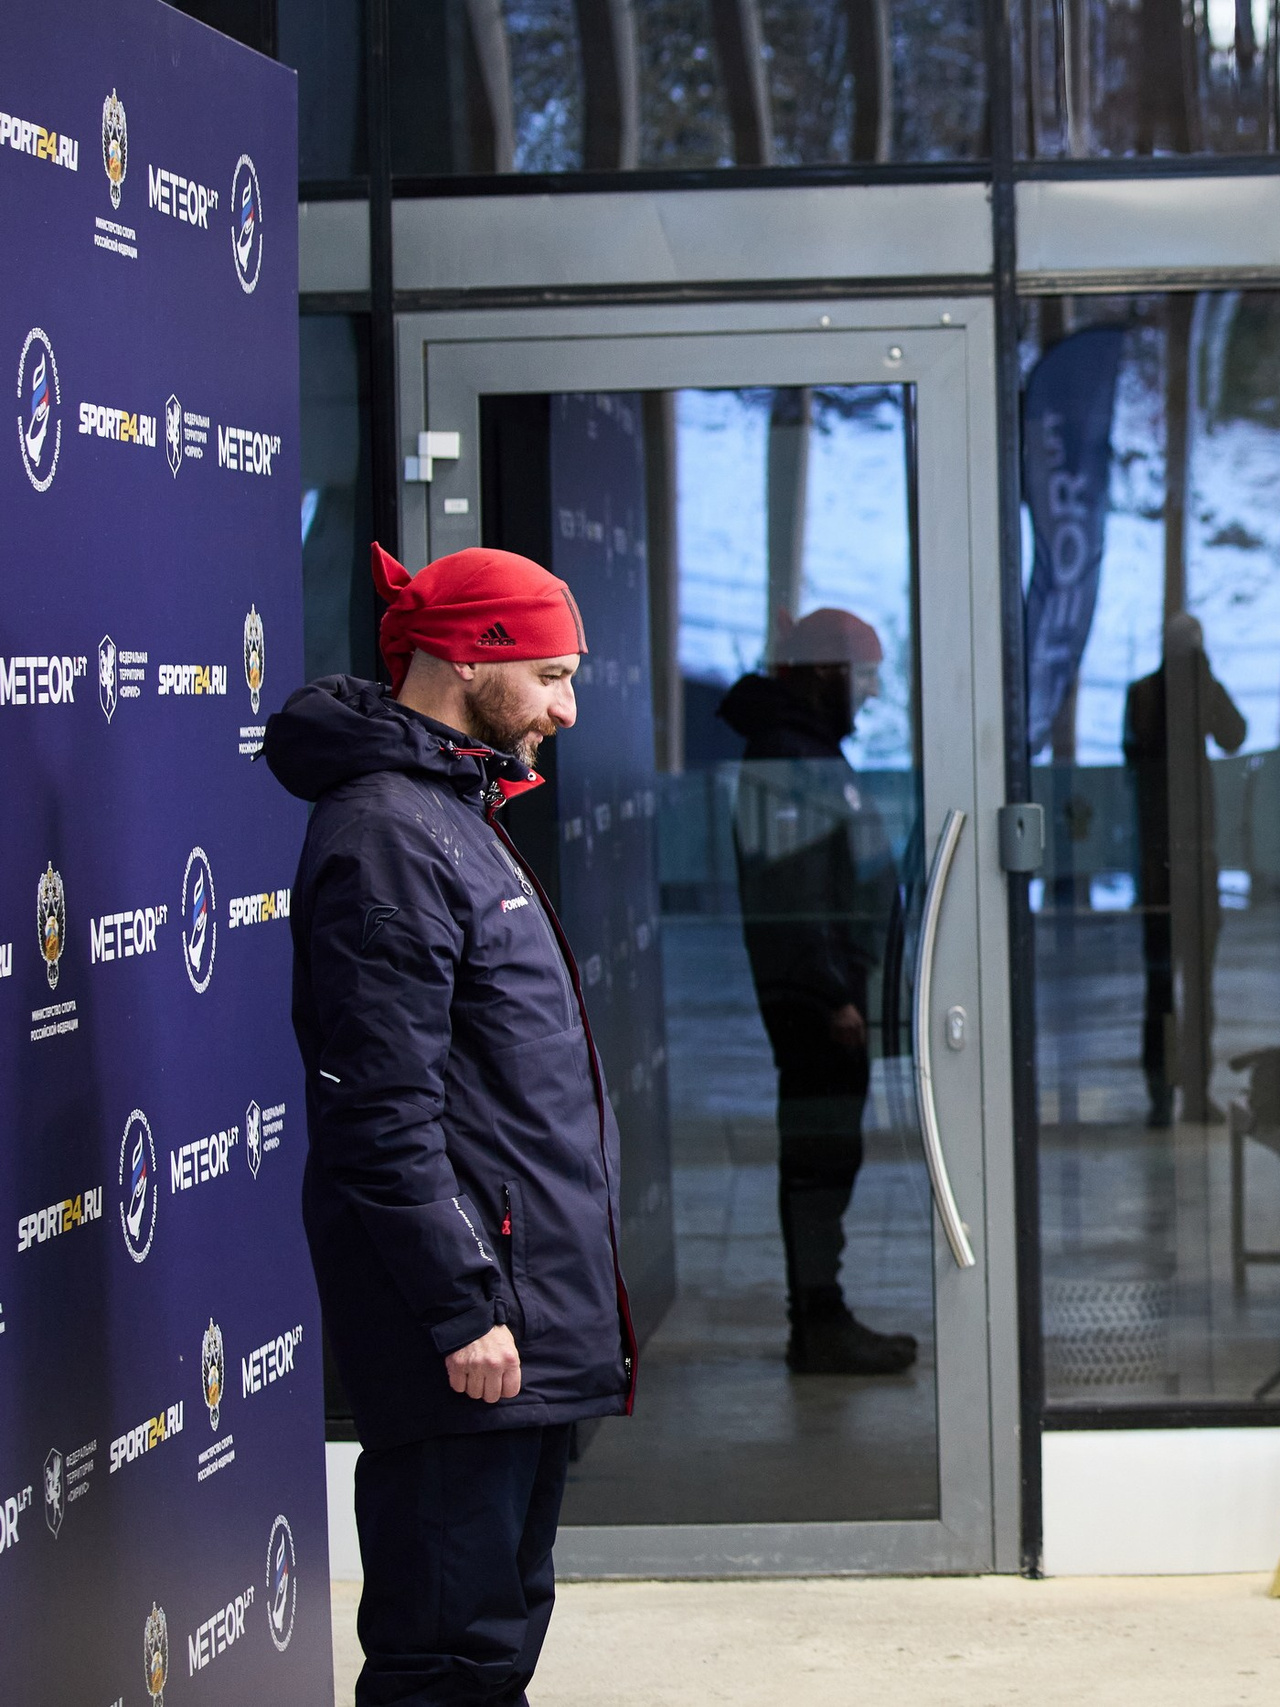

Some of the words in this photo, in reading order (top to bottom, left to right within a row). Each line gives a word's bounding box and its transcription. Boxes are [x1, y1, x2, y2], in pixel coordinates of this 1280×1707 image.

[0, 112, 78, 172] PORT24.RU
[149, 164, 208, 229] METEOR
[78, 402, 156, 447] SPORT24.RU
[217, 424, 272, 476] METEOR
[475, 638, 517, 646] adidas
[0, 655, 75, 706] METEOR
[158, 664, 227, 695] SPORT24.RU
[90, 908, 157, 965] METEOR
[229, 888, 291, 929] SPORT24.RU
[170, 1131, 229, 1194] METEOR
[18, 1186, 103, 1253] SPORT24.RU
[241, 1332, 295, 1399] METEOR
[109, 1401, 184, 1475] SPORT24.RU
[188, 1595, 246, 1678] METEOR
